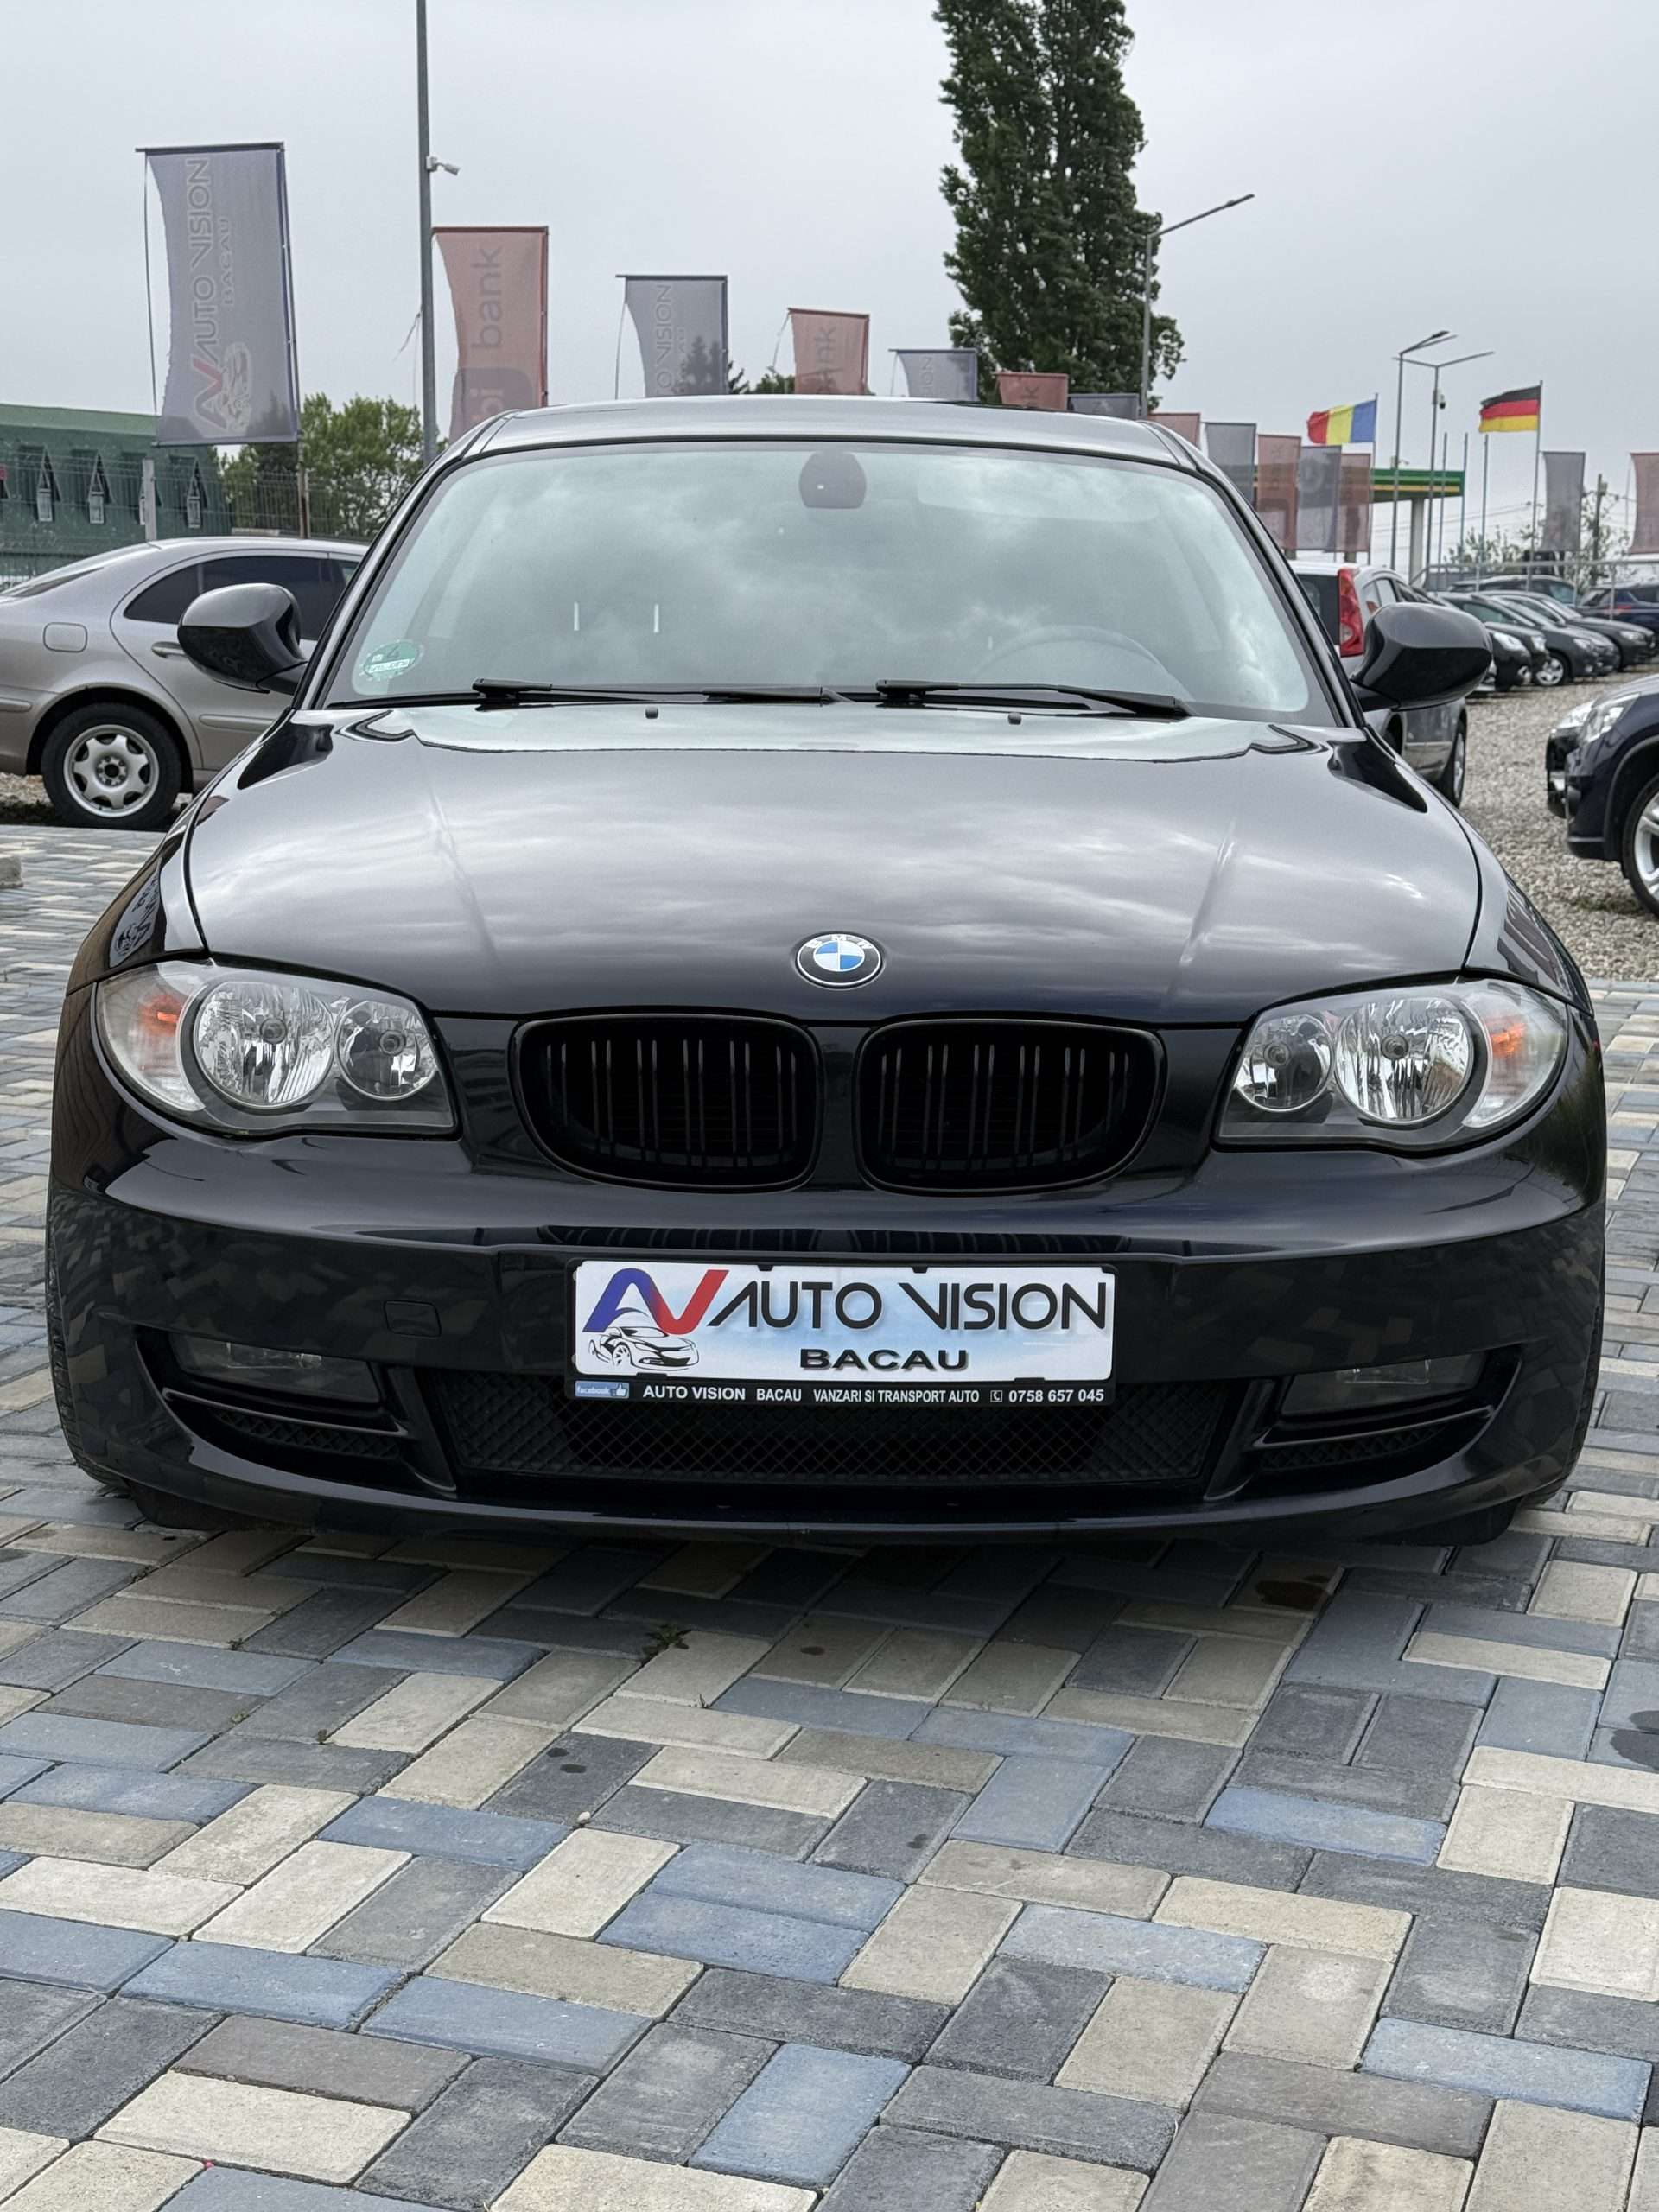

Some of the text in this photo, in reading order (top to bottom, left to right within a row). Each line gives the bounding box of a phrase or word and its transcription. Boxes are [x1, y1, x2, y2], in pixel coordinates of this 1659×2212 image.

[185, 159, 219, 363] AUTO VISION
[472, 245, 503, 349] bank
[657, 284, 671, 364] VISION
[707, 1281, 1107, 1330] AUTO VISION
[799, 1348, 968, 1370] BACAU
[643, 1385, 1104, 1403] AUTO VISION BACAU VANZARI SI TRANSPORT AUTO 0758 657 045
